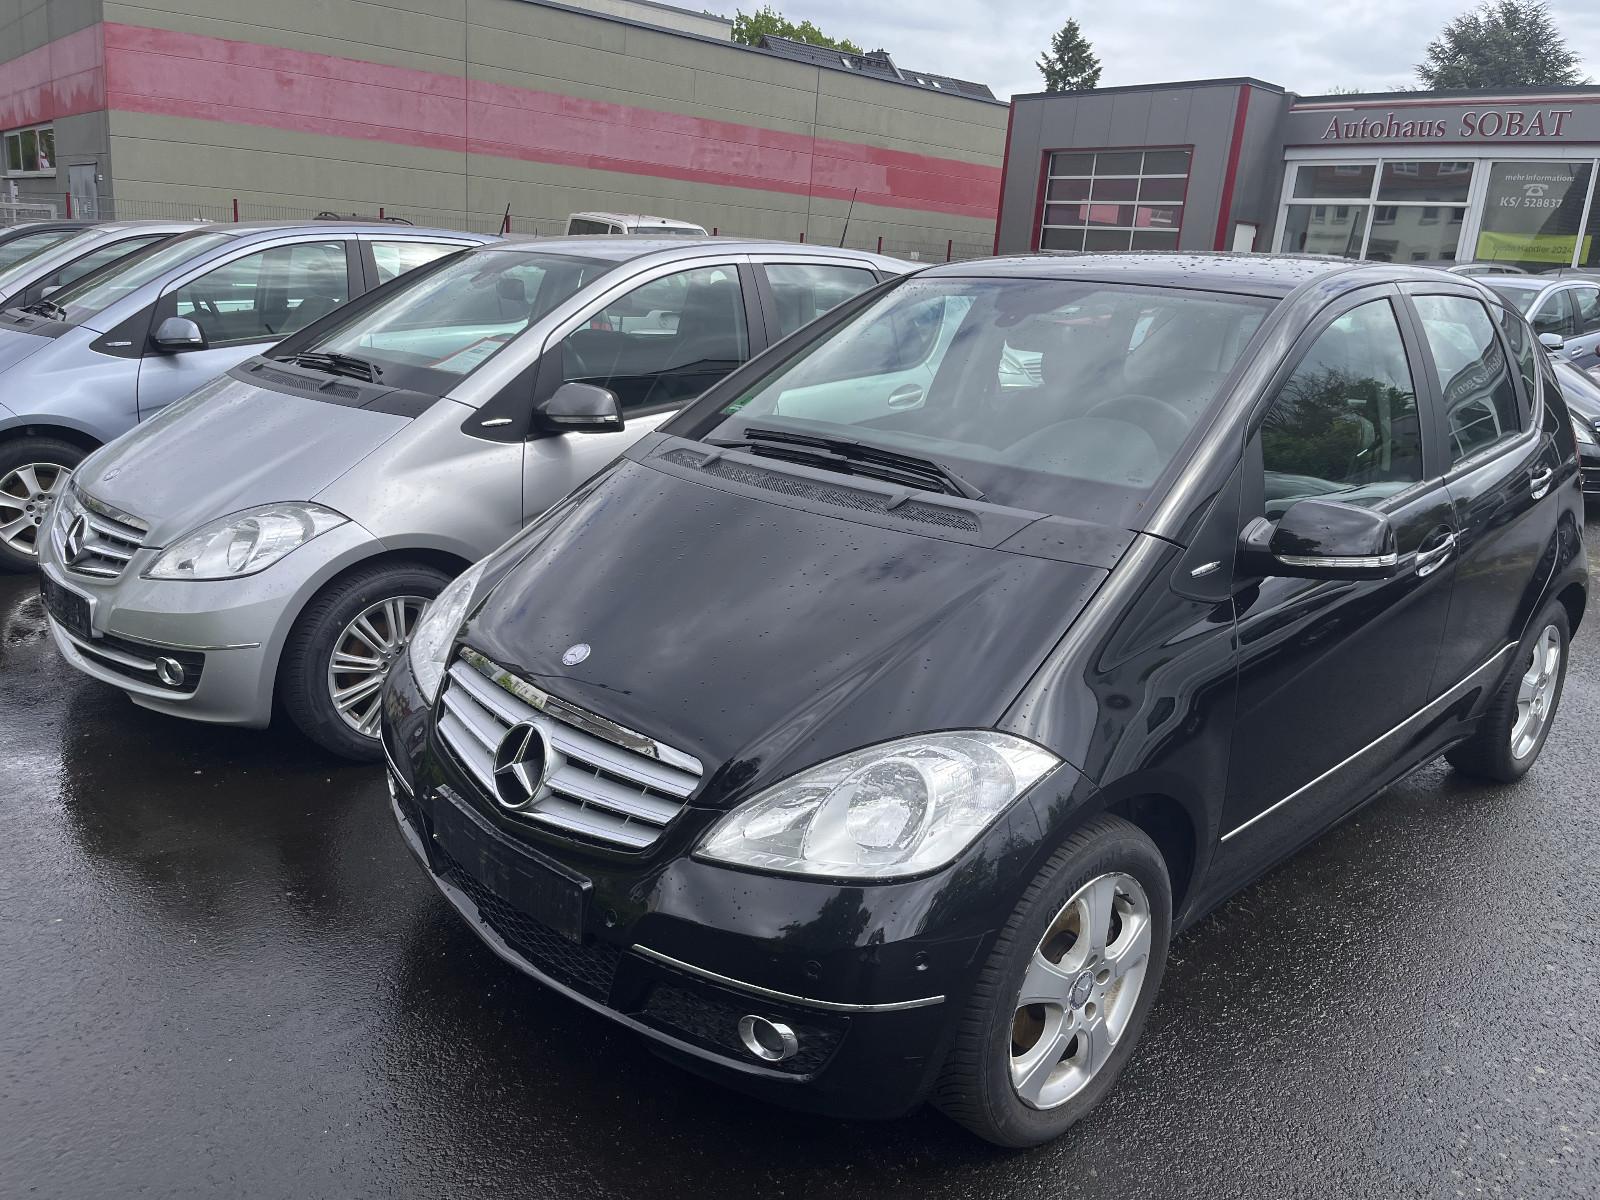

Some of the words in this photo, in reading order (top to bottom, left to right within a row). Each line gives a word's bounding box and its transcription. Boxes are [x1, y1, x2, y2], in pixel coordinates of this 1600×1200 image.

[1321, 112, 1447, 140] Autohaus
[1459, 109, 1573, 137] SOBAT
[1505, 172, 1525, 182] mehr
[1500, 196, 1521, 208] KS/
[1523, 198, 1563, 208] 528837
